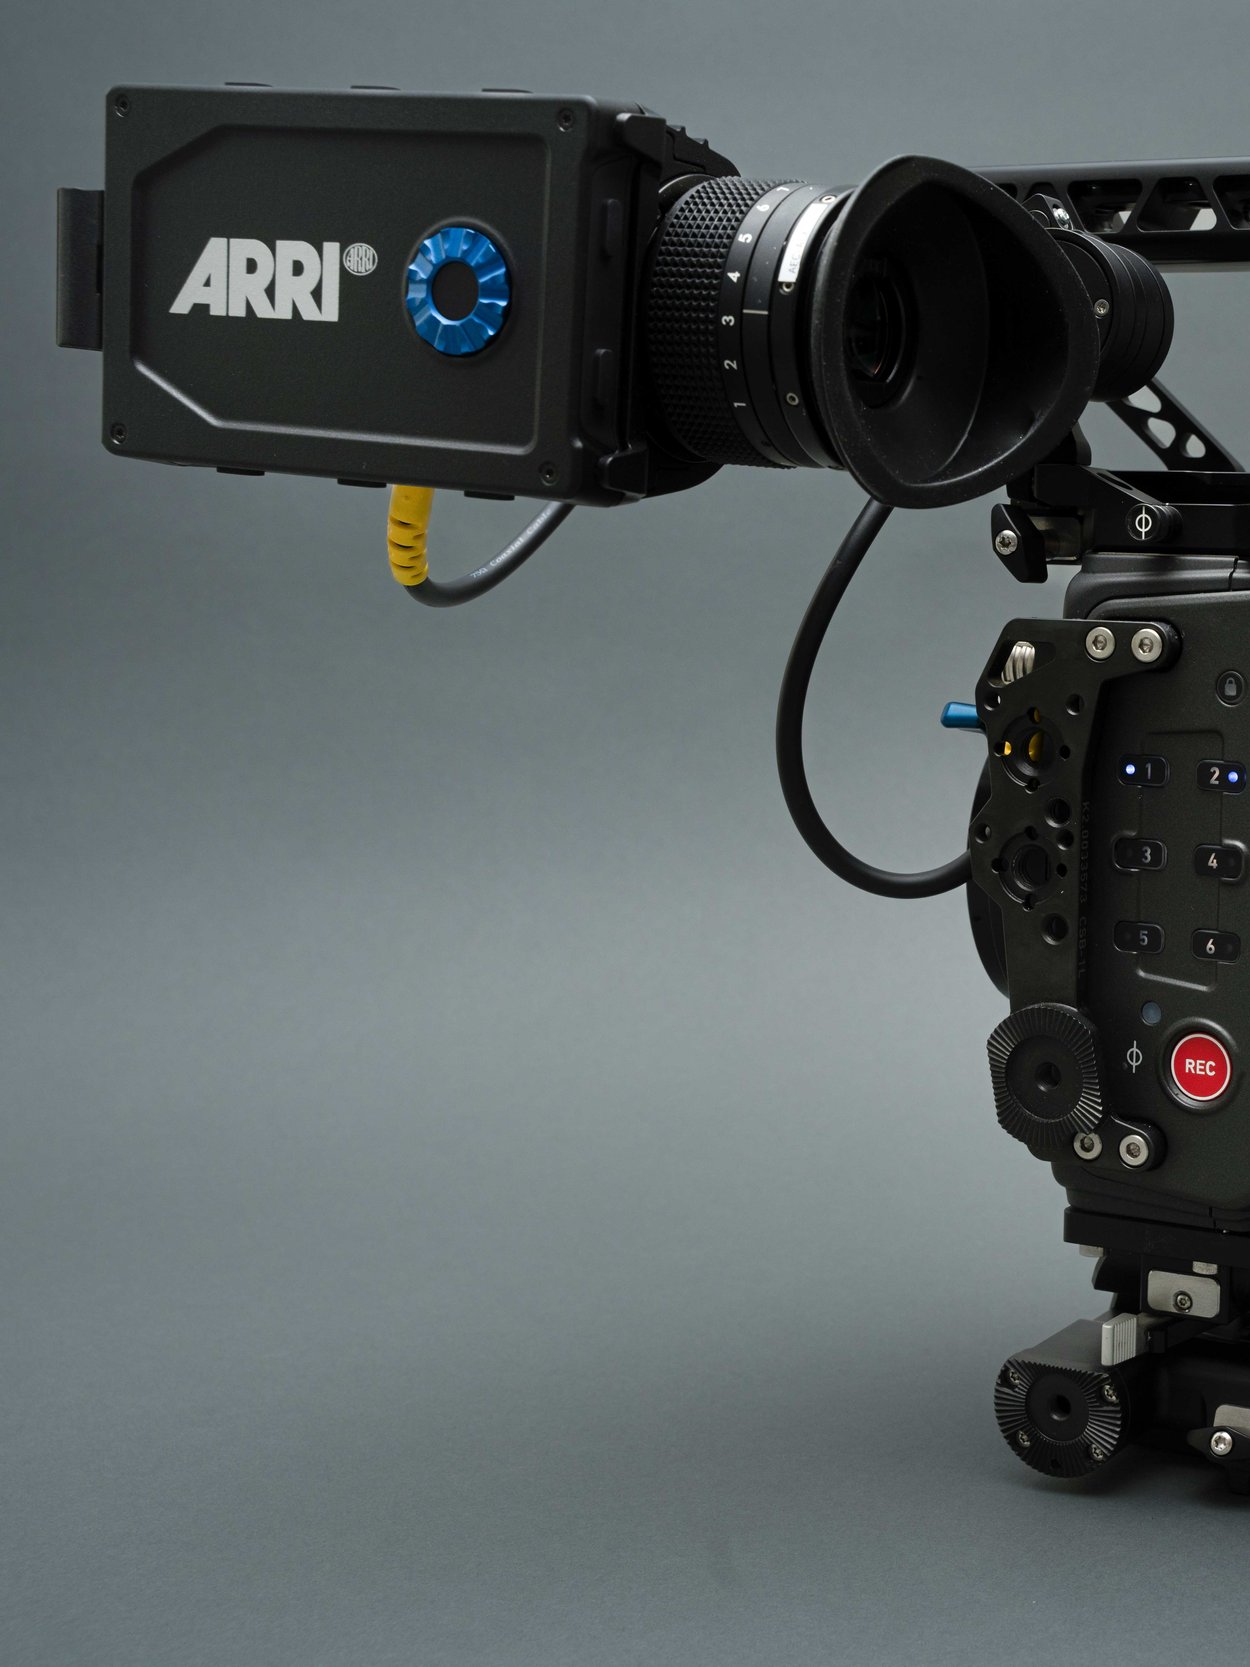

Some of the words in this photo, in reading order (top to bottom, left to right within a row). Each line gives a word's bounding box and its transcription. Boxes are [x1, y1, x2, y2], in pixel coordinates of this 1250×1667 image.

[756, 203, 770, 213] 6
[738, 232, 753, 244] 5
[168, 237, 341, 322] ARRI
[345, 244, 375, 275] ARRI
[726, 270, 741, 284] 4
[721, 314, 736, 327] 3
[723, 358, 738, 371] 2
[1145, 762, 1152, 780] 1
[1209, 766, 1220, 785] 2
[1141, 845, 1152, 864] 3
[1207, 852, 1218, 870] 4
[1139, 930, 1149, 946] 5
[1205, 938, 1216, 955] 6
[1184, 1058, 1216, 1077] REC
